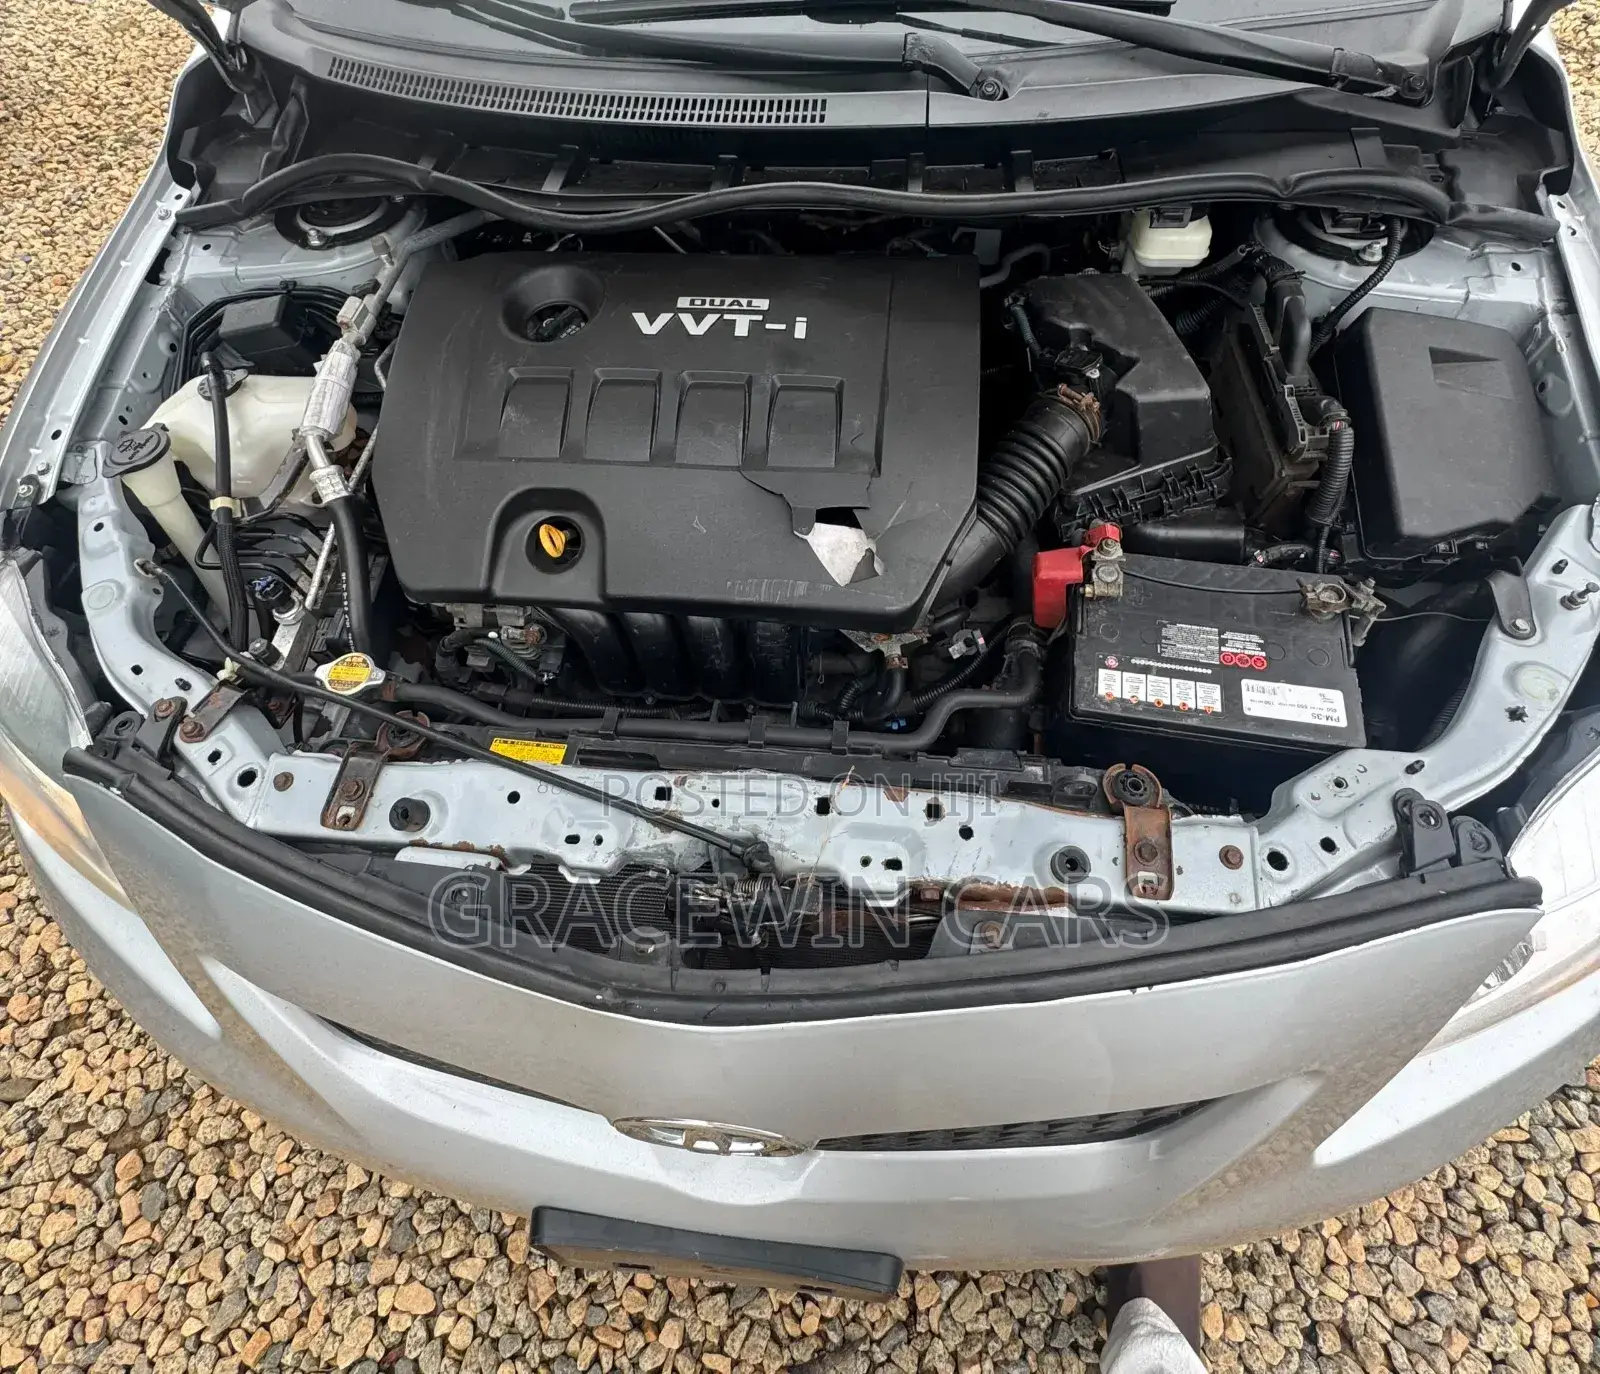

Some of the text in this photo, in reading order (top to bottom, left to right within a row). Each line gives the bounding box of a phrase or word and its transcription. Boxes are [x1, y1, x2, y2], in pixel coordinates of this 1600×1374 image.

[688, 297, 762, 309] DUAL
[631, 312, 808, 340] VVT-i
[1311, 712, 1341, 723] PM-35
